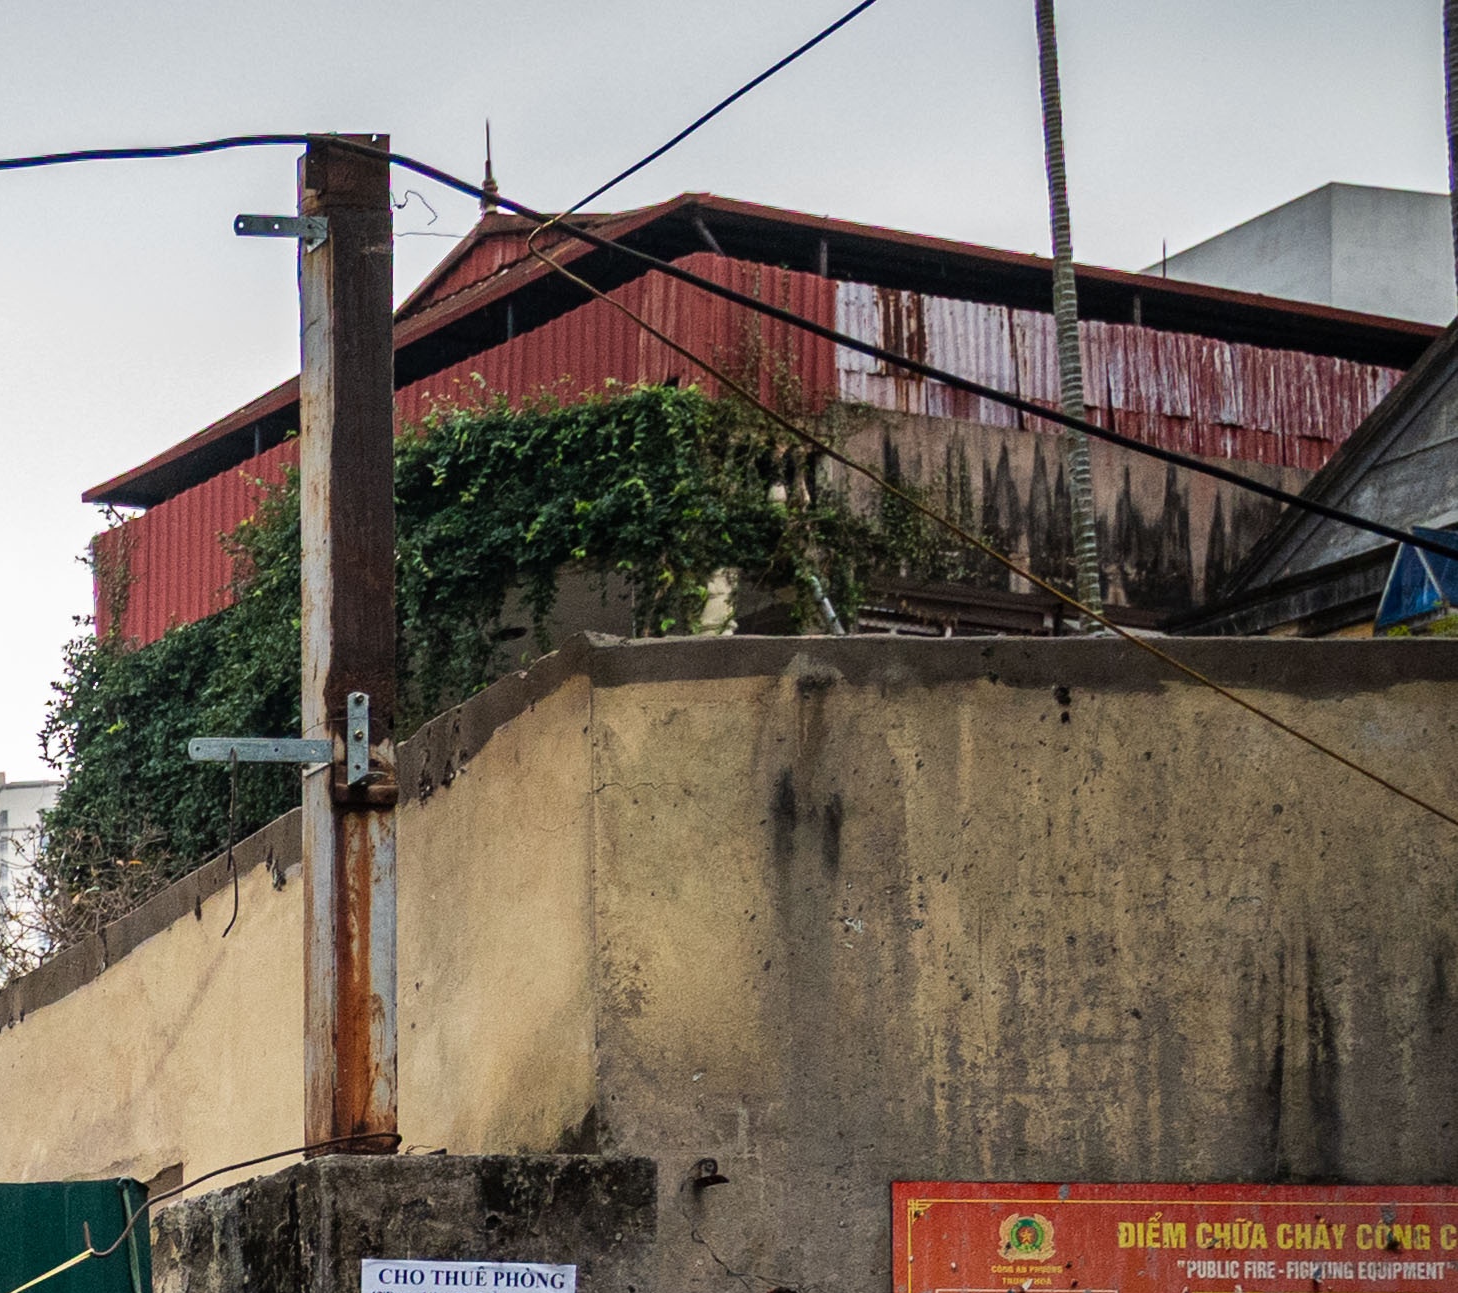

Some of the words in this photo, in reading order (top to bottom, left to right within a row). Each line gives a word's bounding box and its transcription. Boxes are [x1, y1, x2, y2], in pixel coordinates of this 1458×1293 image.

[1118, 1212, 1187, 1249] ĐIỂM
[1196, 1218, 1268, 1249] CHỮA
[1277, 1216, 1346, 1250] CHÁY
[379, 1268, 424, 1285] CHO
[431, 1266, 487, 1287] THUÊ
[493, 1267, 565, 1290] PHÒNG
